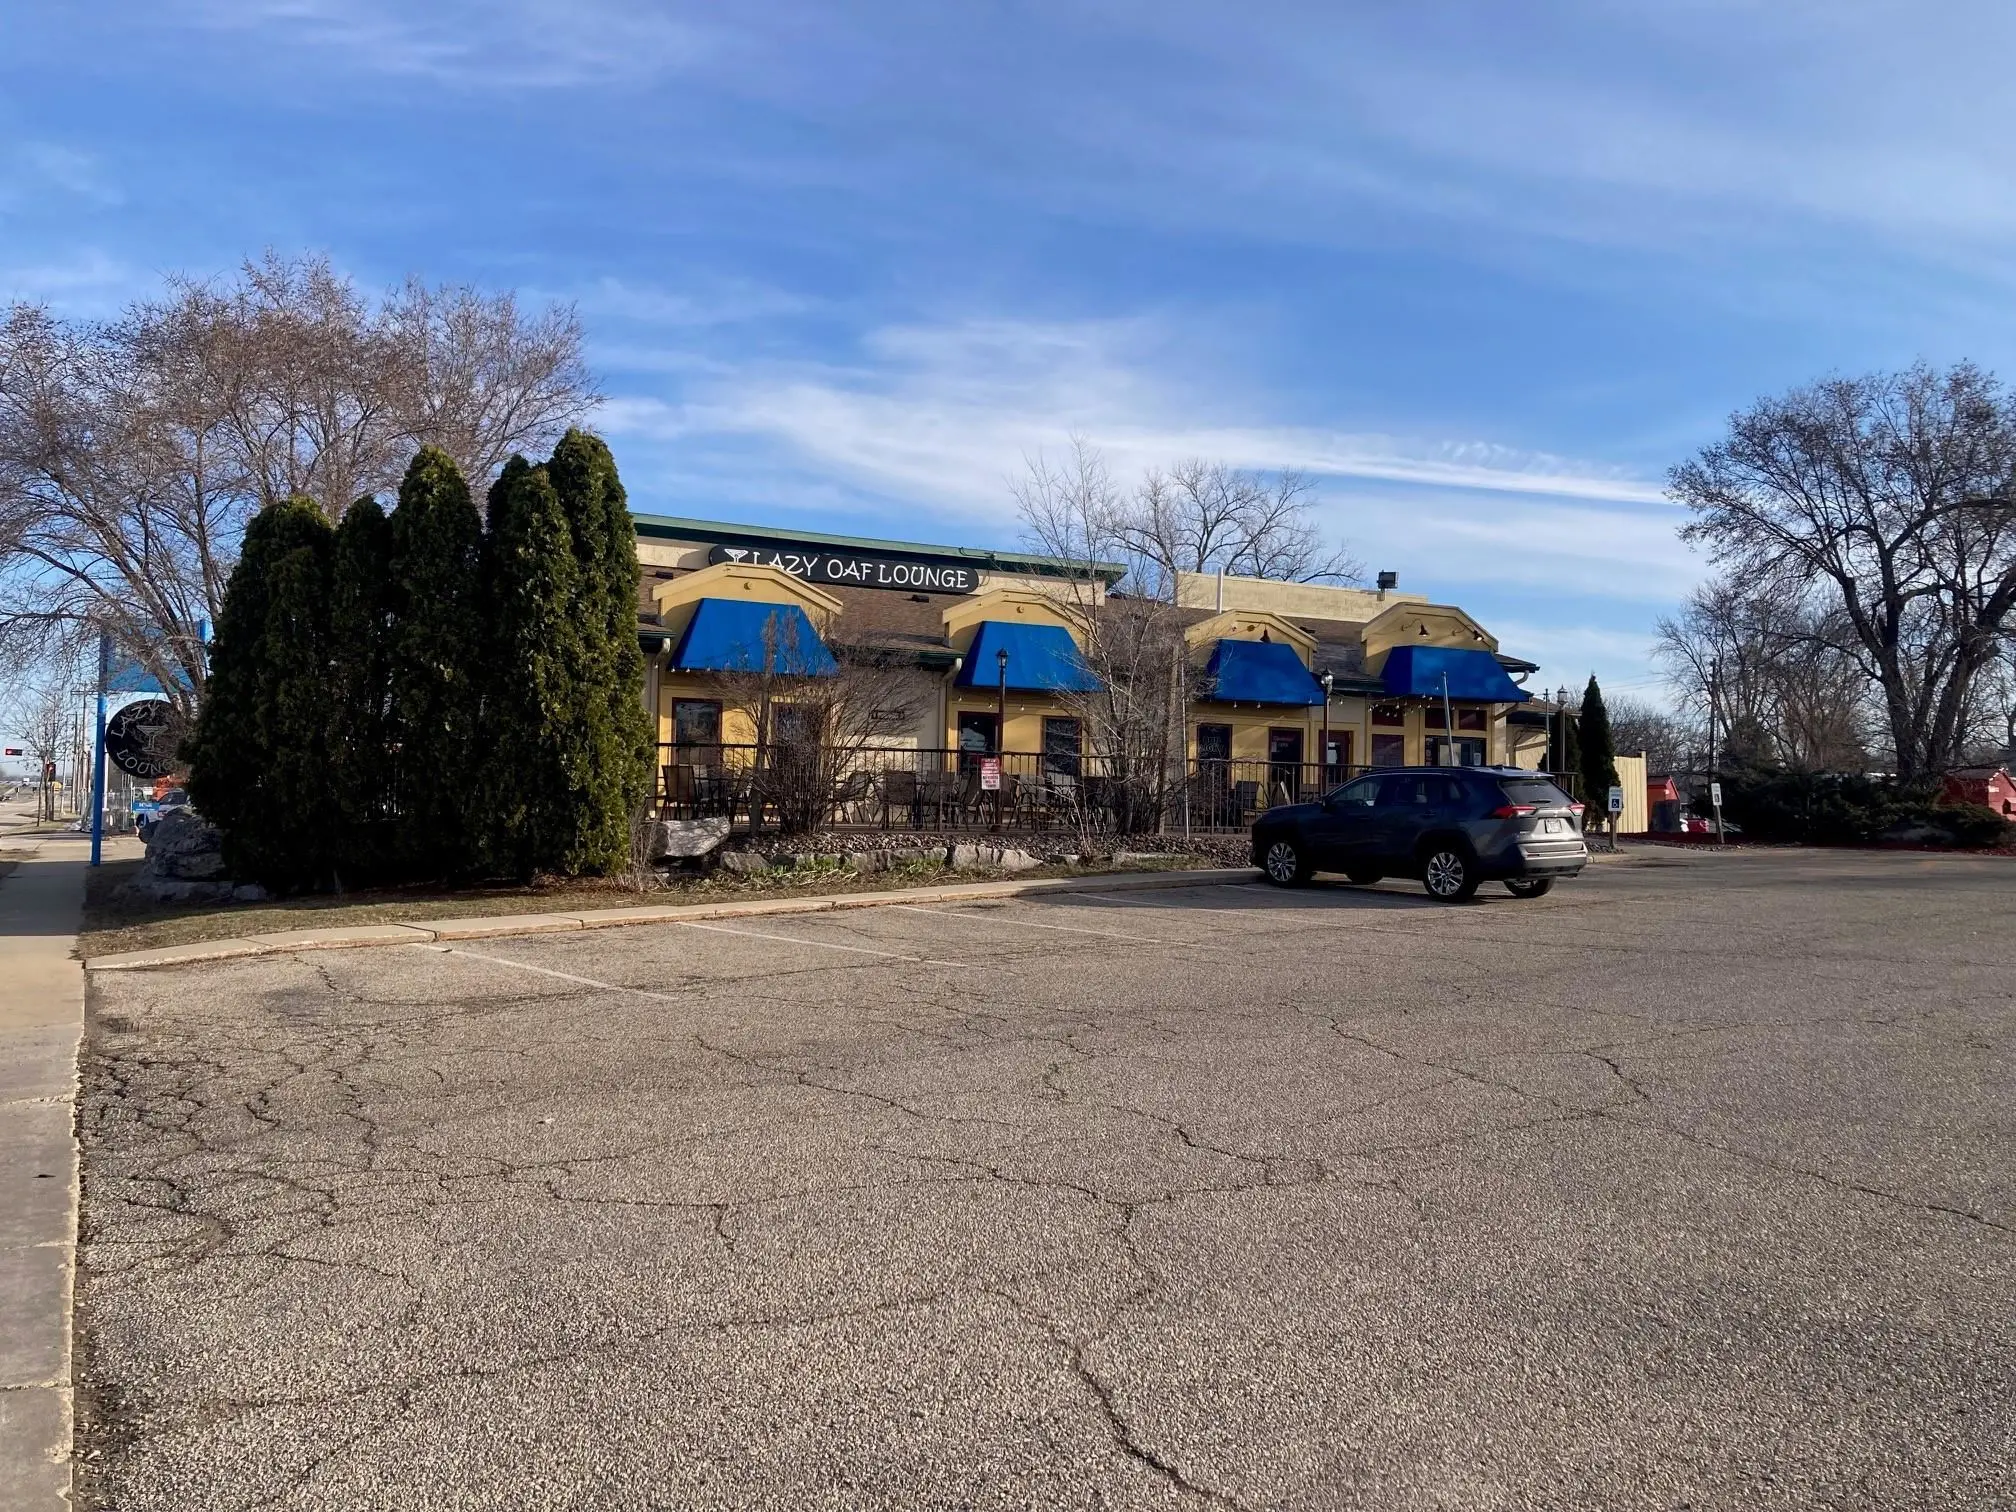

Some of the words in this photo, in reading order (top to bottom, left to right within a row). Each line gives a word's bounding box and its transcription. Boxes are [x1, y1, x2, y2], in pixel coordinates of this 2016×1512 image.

[826, 558, 873, 581] OAF
[877, 564, 969, 588] LOUNGE
[110, 703, 160, 739] LAZY
[116, 748, 175, 775] LOUNG
